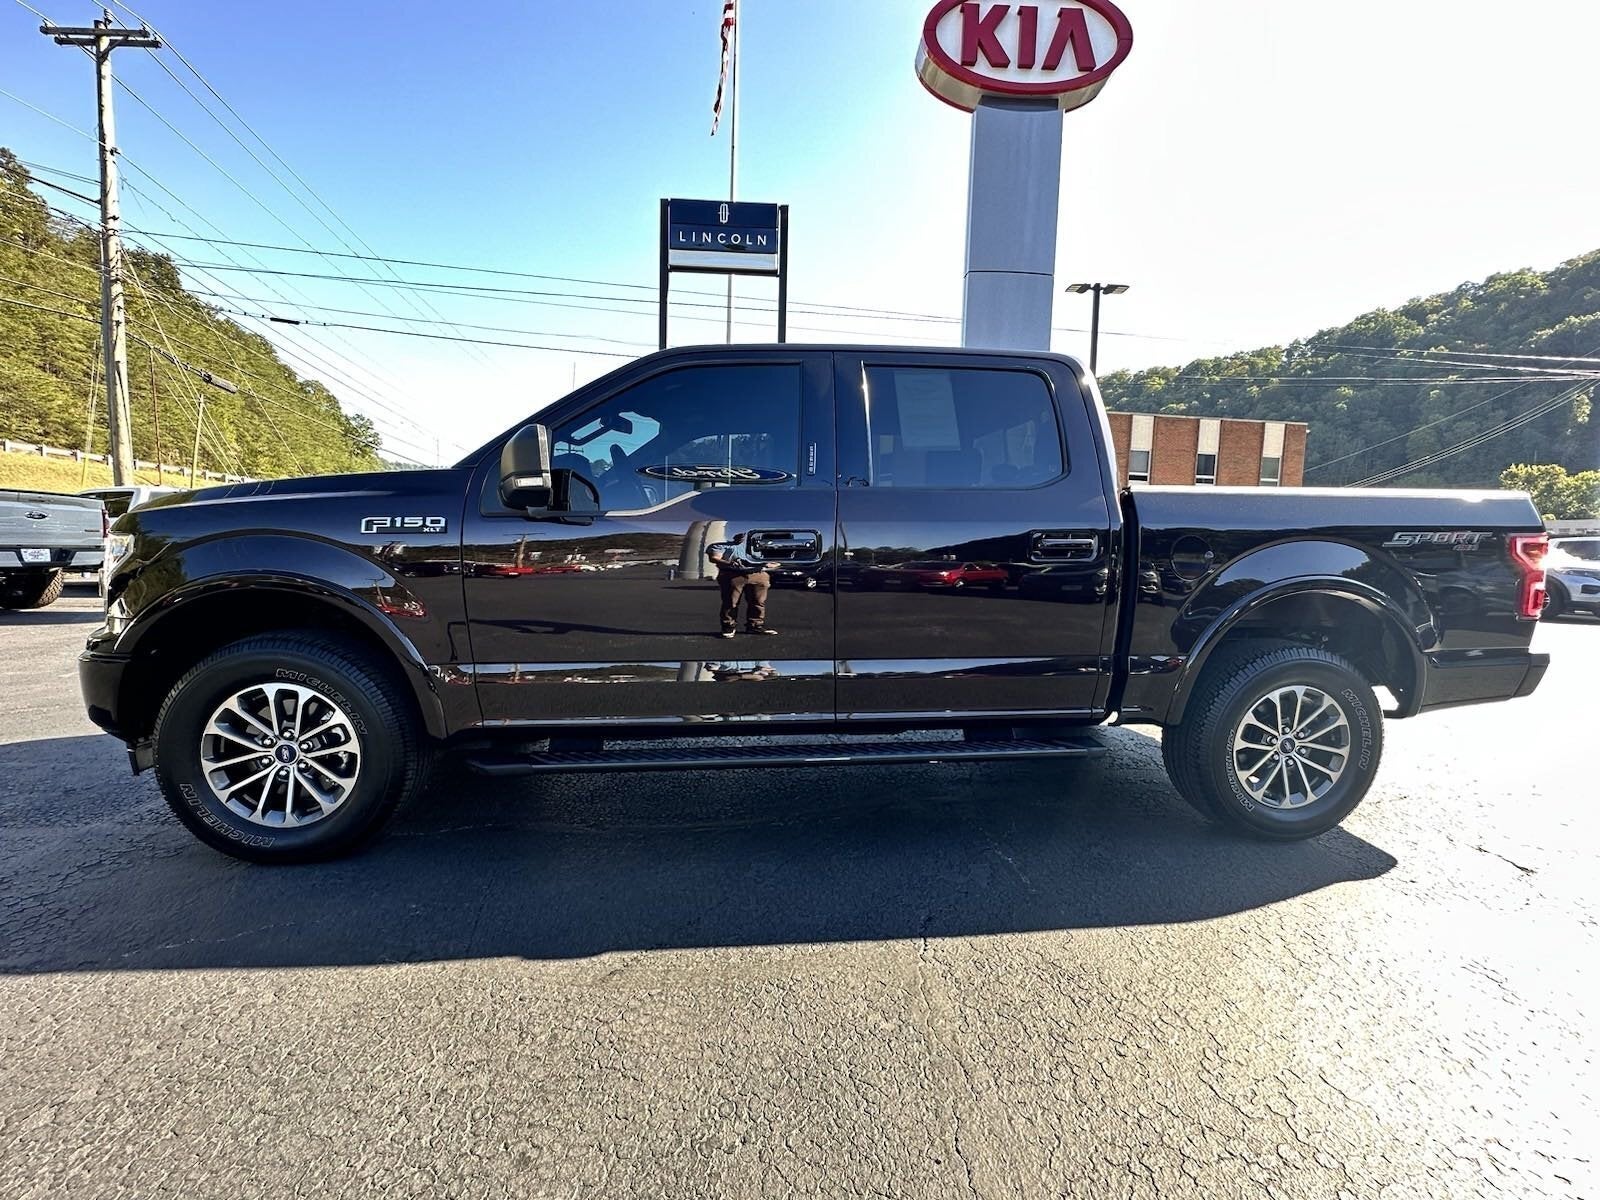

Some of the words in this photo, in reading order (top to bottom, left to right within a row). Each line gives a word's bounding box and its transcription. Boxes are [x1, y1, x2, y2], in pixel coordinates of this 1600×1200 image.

[960, 2, 1096, 72] KIA
[679, 230, 767, 246] LINCOLN
[1381, 531, 1494, 547] SPORT
[275, 667, 368, 735] MICHELIN
[1341, 688, 1372, 770] MICHELIN
[1224, 728, 1255, 812] MICHELIN
[179, 783, 276, 849] MICHELIN
